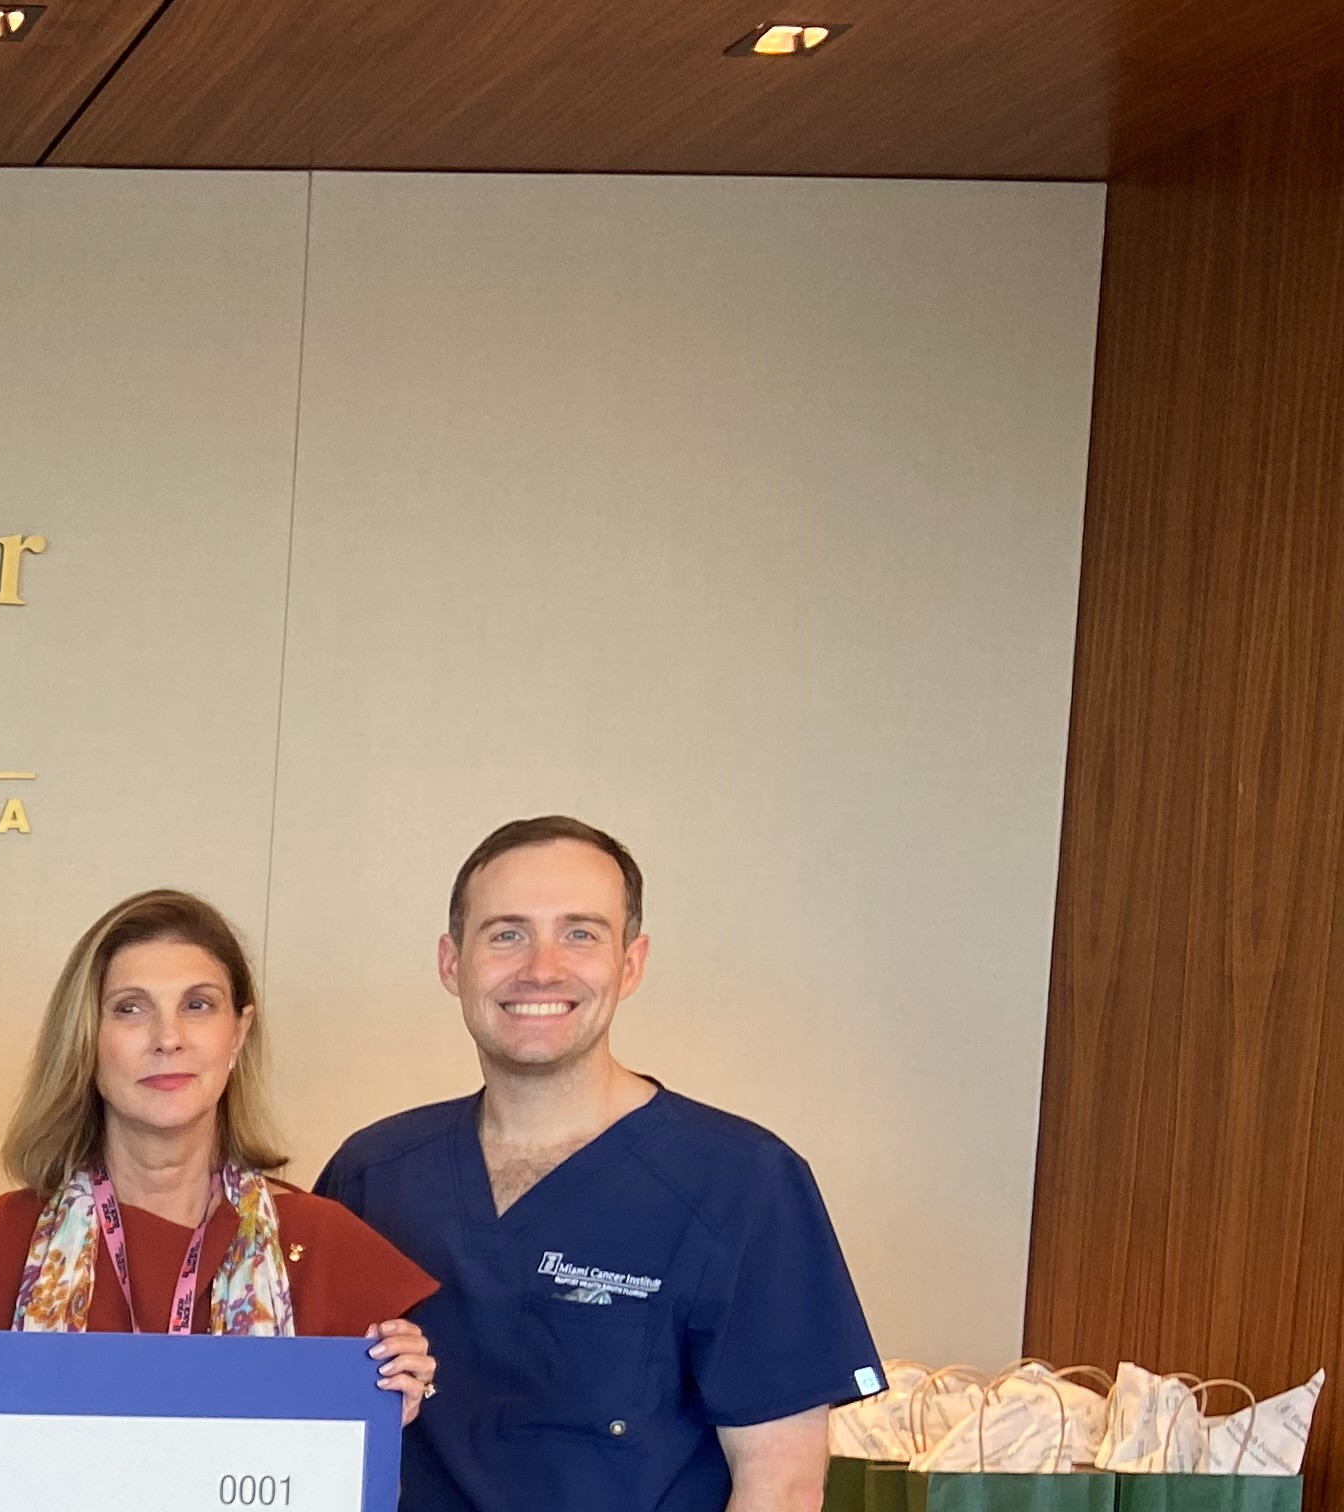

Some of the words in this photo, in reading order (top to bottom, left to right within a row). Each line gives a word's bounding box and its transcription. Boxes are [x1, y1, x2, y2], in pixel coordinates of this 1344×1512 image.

[559, 1263, 590, 1277] Miami
[590, 1267, 626, 1283] Cancer
[219, 1473, 293, 1507] 0001
